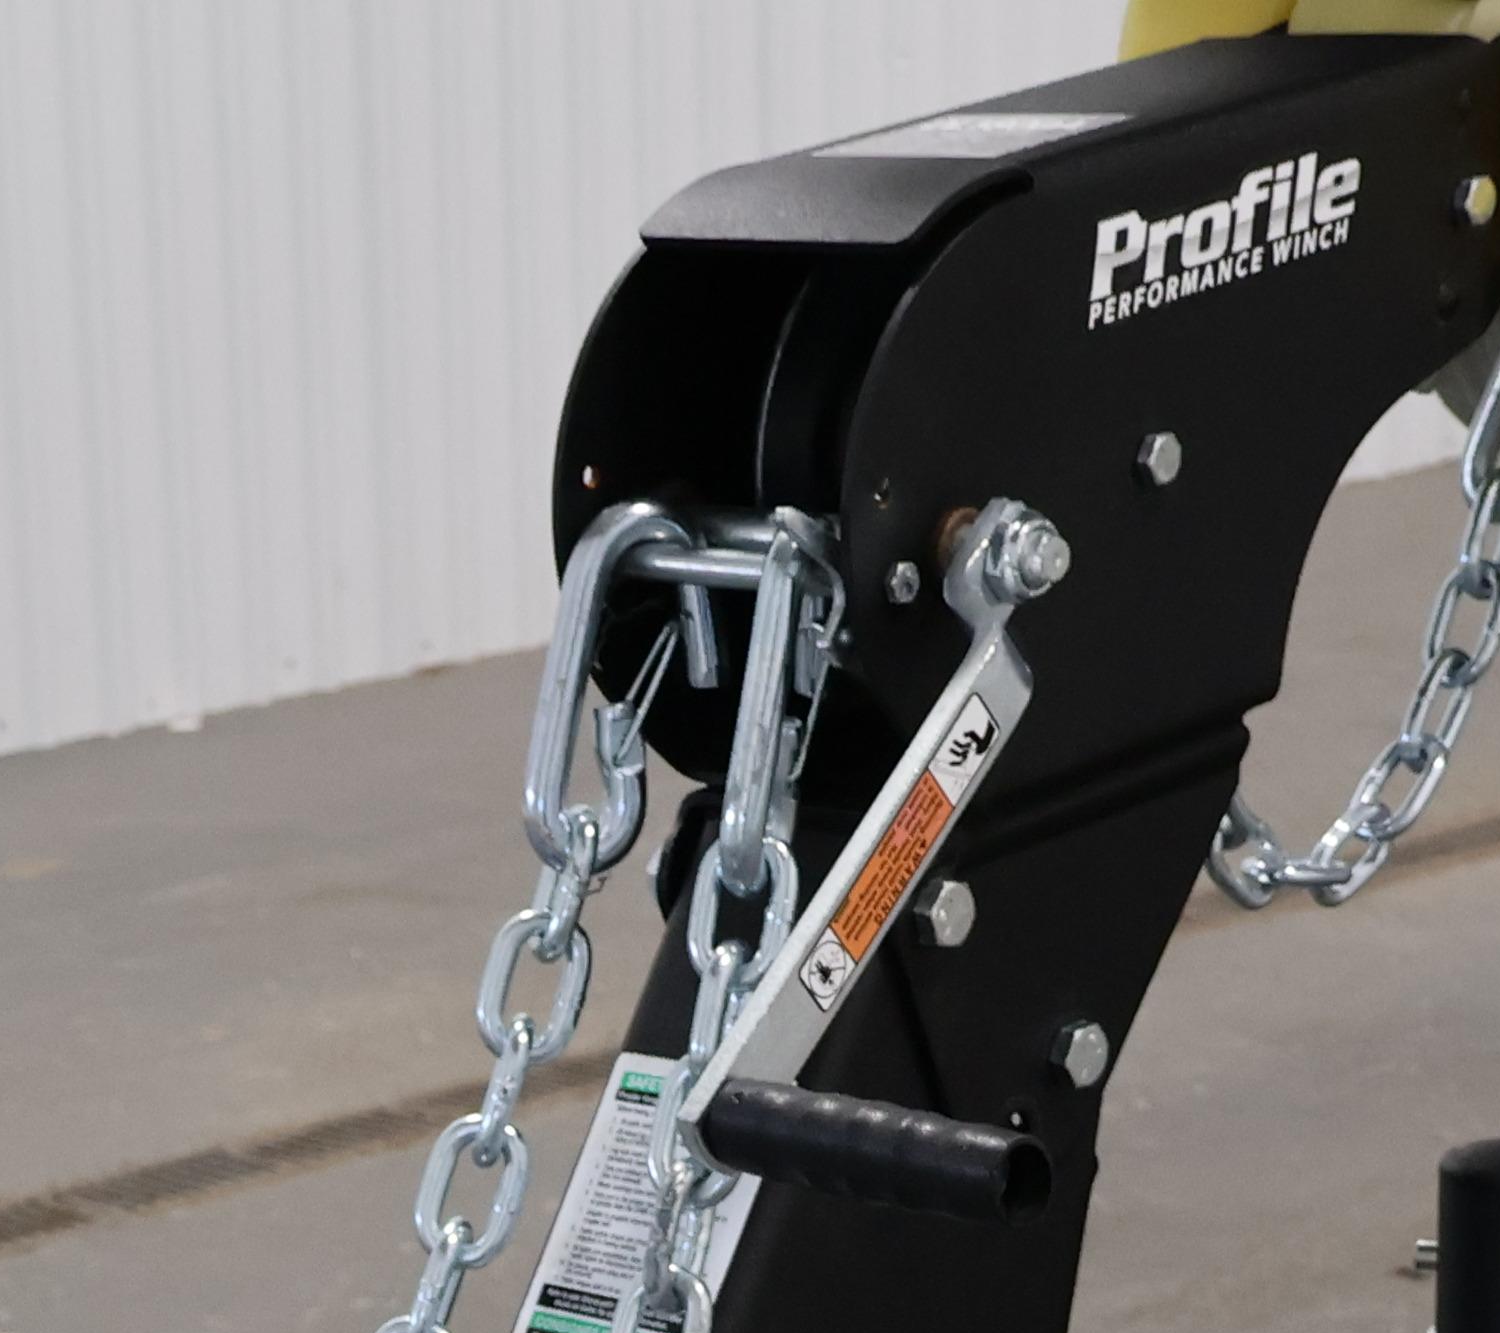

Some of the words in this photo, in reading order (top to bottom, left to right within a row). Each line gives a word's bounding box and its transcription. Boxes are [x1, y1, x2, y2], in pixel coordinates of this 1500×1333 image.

[1088, 246, 1265, 331] PERFORMANCE
[1271, 217, 1350, 267] WINCH
[1090, 151, 1361, 301] Profile
